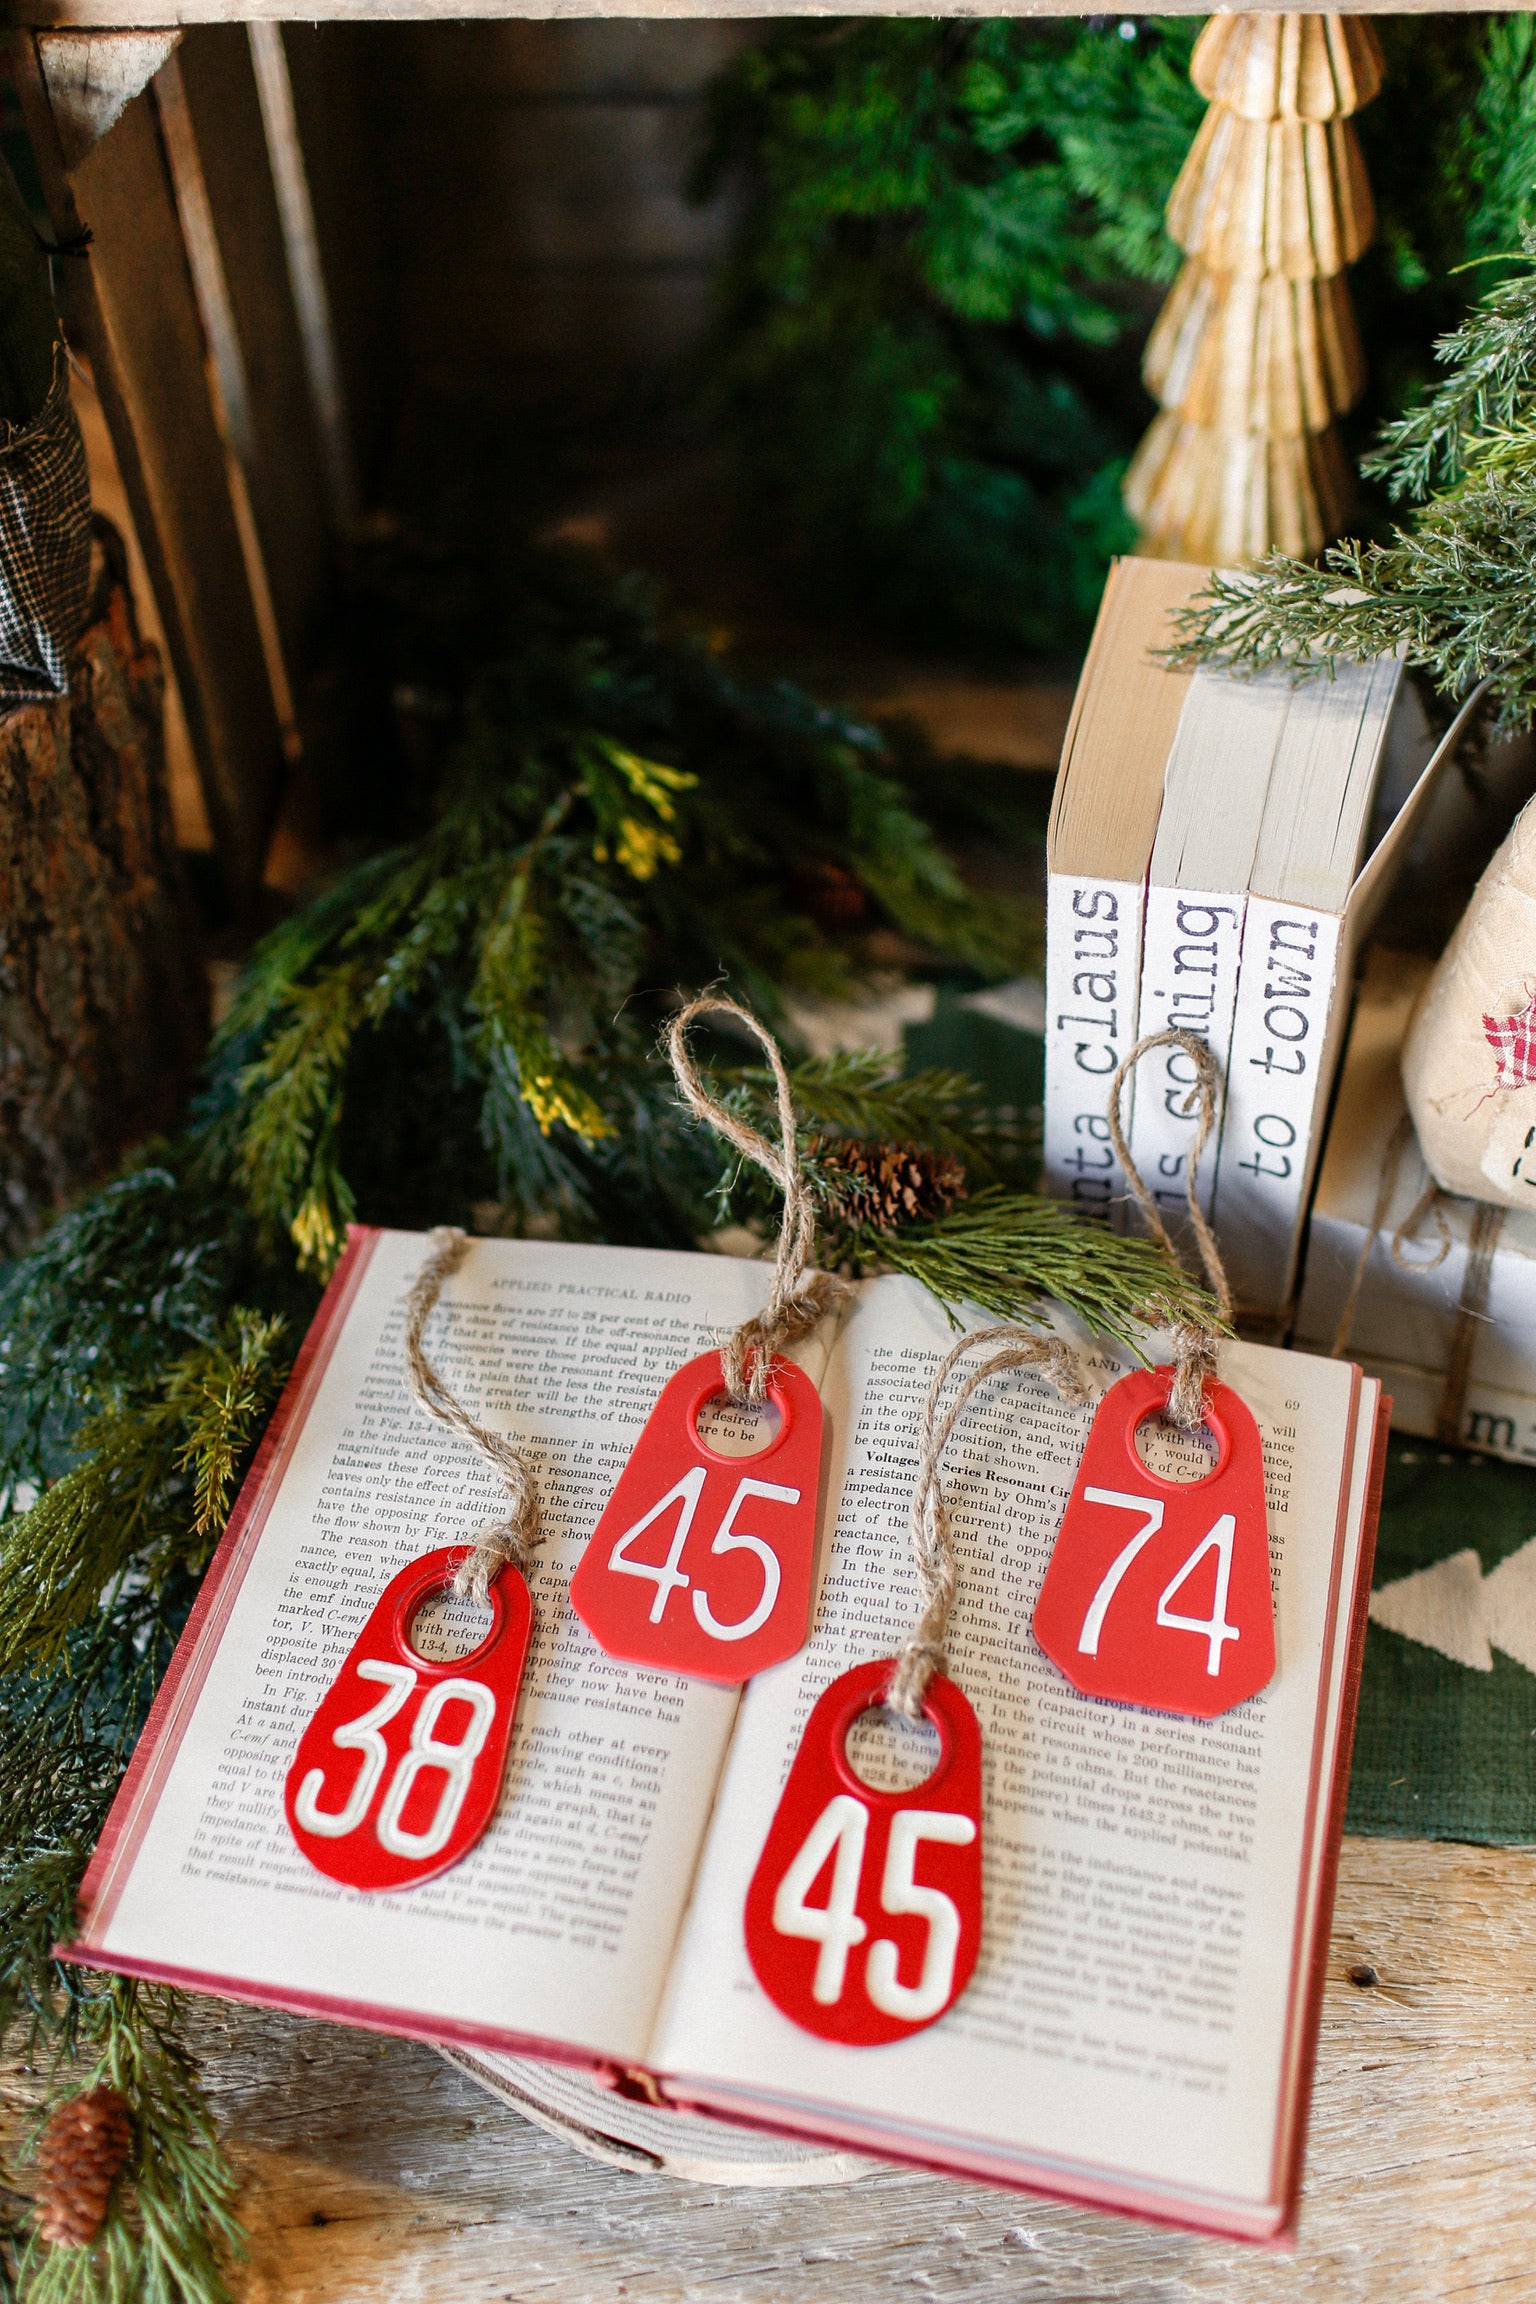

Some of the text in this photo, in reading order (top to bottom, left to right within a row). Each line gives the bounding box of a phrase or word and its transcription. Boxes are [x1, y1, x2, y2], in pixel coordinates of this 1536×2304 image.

[1057, 888, 1118, 1074] claus
[1154, 901, 1238, 1120] coming
[1239, 920, 1319, 1178] to town
[490, 1279, 691, 1304] APPLIED PRACTICAL RADIO
[485, 1387, 603, 1406] greater will be the
[869, 1360, 1051, 1399] become force
[1087, 1356, 1301, 1411] AND 69
[484, 1399, 760, 1428] with the strengths of desired
[863, 1389, 1081, 1437] the curve capacitor
[877, 1404, 898, 1417] the
[973, 1388, 1077, 1421] the capacitance
[381, 1431, 593, 1465] inductance on the
[506, 1430, 578, 1448] the manner
[1271, 1425, 1296, 1439] will
[336, 1442, 400, 1457] magnitude
[403, 1449, 429, 1461] and
[432, 1453, 484, 1467] opposite
[961, 1447, 990, 1464] that
[1009, 1441, 1072, 1467] the effect
[326, 1468, 449, 1493] leaves only the effect
[387, 1460, 594, 1496] these forces that changes
[865, 1450, 1046, 1493] Voltages Series Resonant
[316, 1497, 466, 1526] have the opposing force
[321, 1485, 507, 1515] contains resistance in addition
[843, 1481, 1036, 1524] impedance drop
[944, 1477, 1057, 1512] shown by Ohm's
[311, 1512, 331, 1525] the
[333, 1515, 360, 1528] flow
[361, 1519, 401, 1534] shown
[404, 1523, 421, 1536] by
[836, 1512, 1009, 1549] uct of the and the
[856, 1495, 1040, 1540] electron (current) the
[320, 1529, 419, 1553] The reason that
[344, 1550, 373, 1562] even
[608, 1467, 801, 1641] 45
[294, 1559, 339, 1575] exactly
[829, 1541, 1023, 1585] the flow and the
[999, 1553, 1032, 1573] drop
[282, 1586, 336, 1604] the emf
[304, 1576, 349, 1591] enough
[821, 1572, 1010, 1616] inductive and the
[1078, 1487, 1240, 1677] 74
[818, 1588, 849, 1603] both
[852, 1595, 890, 1609] equal
[894, 1599, 908, 1612] to
[276, 1603, 597, 1657] marked C-emf with voltage
[812, 1622, 846, 1636] what
[848, 1628, 902, 1644] greater
[815, 1605, 916, 1630] the inductance
[259, 1647, 680, 1723] displaced because resistance has
[265, 1635, 685, 1708] opposite they now have been
[587, 1660, 629, 1678] forces
[635, 1671, 669, 1685] were
[674, 1676, 689, 1691] in
[807, 1638, 1088, 1702] only the the potential
[241, 1699, 584, 1761] instant following
[530, 1726, 605, 1746] each other
[1012, 1709, 1261, 1775] the circuit whose performance has
[1037, 1697, 1261, 1758] (capacitor) in series resonant
[296, 1659, 496, 1859] 38
[1041, 1735, 1159, 1769] resonance 200
[773, 1795, 977, 2019] 45
